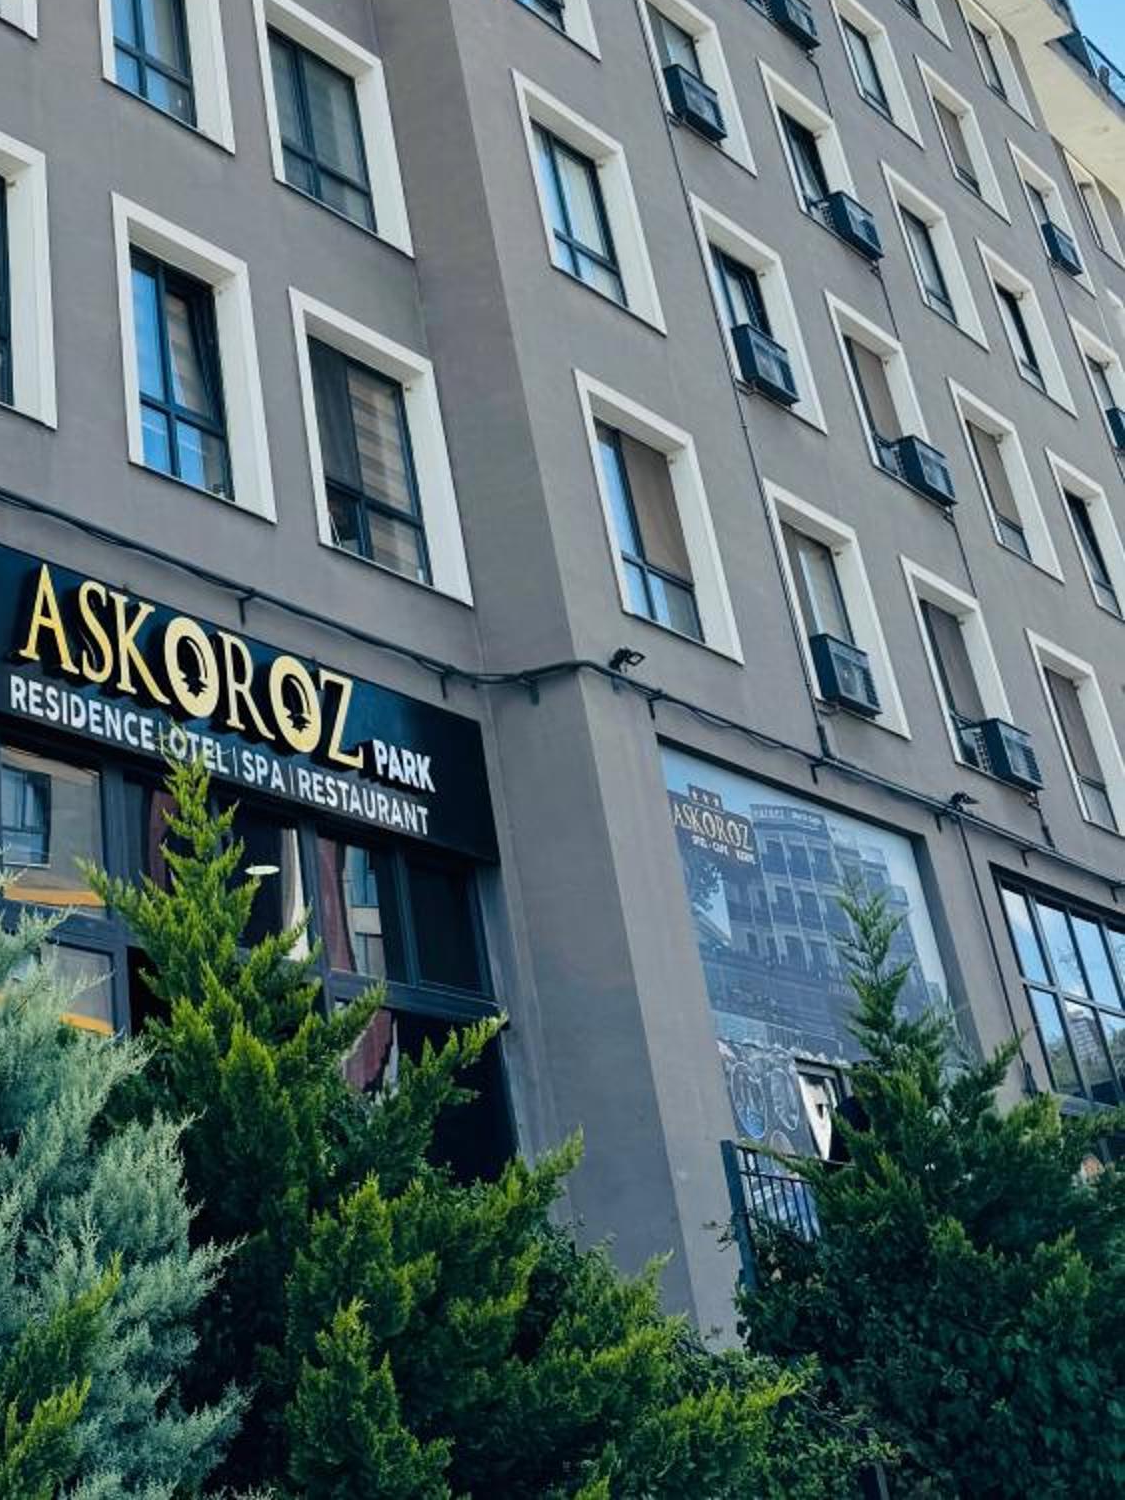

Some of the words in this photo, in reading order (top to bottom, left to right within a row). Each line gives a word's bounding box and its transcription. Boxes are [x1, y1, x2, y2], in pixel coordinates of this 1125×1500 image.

[10, 675, 155, 751] RESIDENCE
[170, 726, 229, 775] OTEL
[241, 750, 286, 793] SPA
[298, 771, 428, 836] RESTAURANT
[19, 563, 364, 769] ASKOROZ
[373, 740, 435, 793] PARK
[674, 803, 754, 850] ASKOROZ
